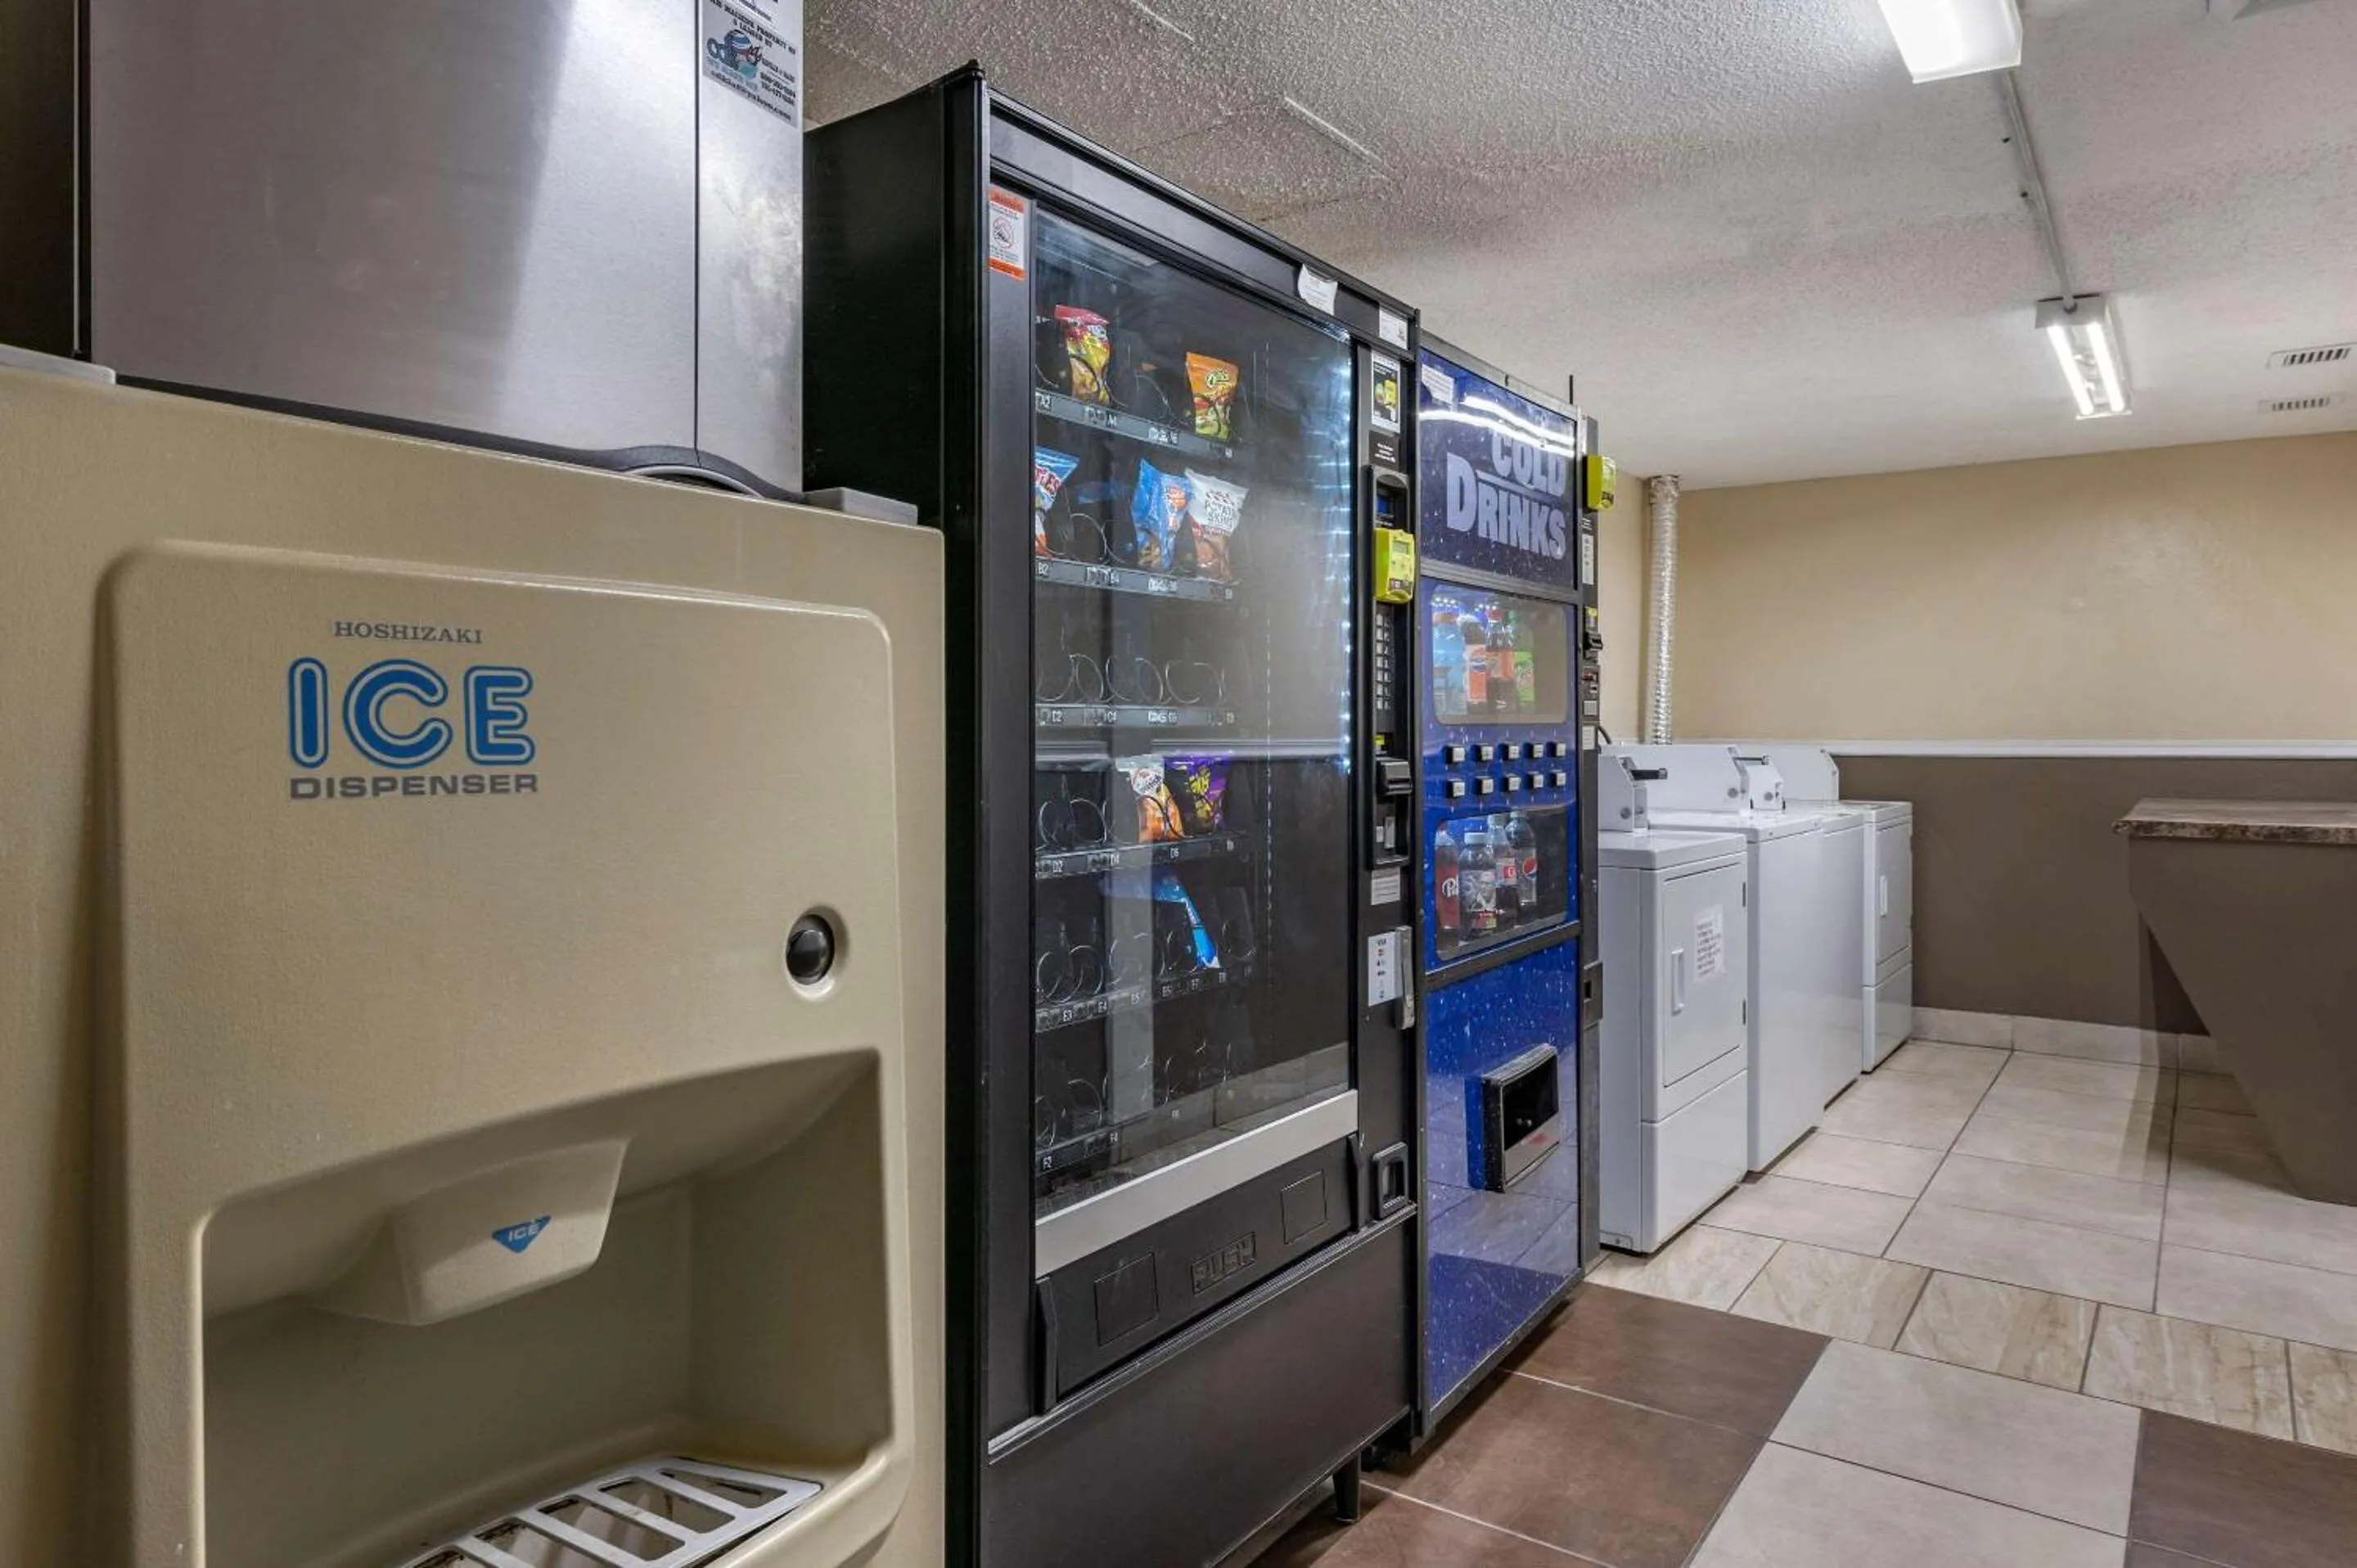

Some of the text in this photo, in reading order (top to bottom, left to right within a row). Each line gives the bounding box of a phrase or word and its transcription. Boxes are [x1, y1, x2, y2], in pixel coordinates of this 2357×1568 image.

[1446, 452, 1566, 560] DRINKS
[334, 621, 482, 643] HOSHIZAKI
[288, 657, 535, 769] ICE
[290, 774, 539, 800] DISPENSER
[507, 1223, 539, 1242] ICE
